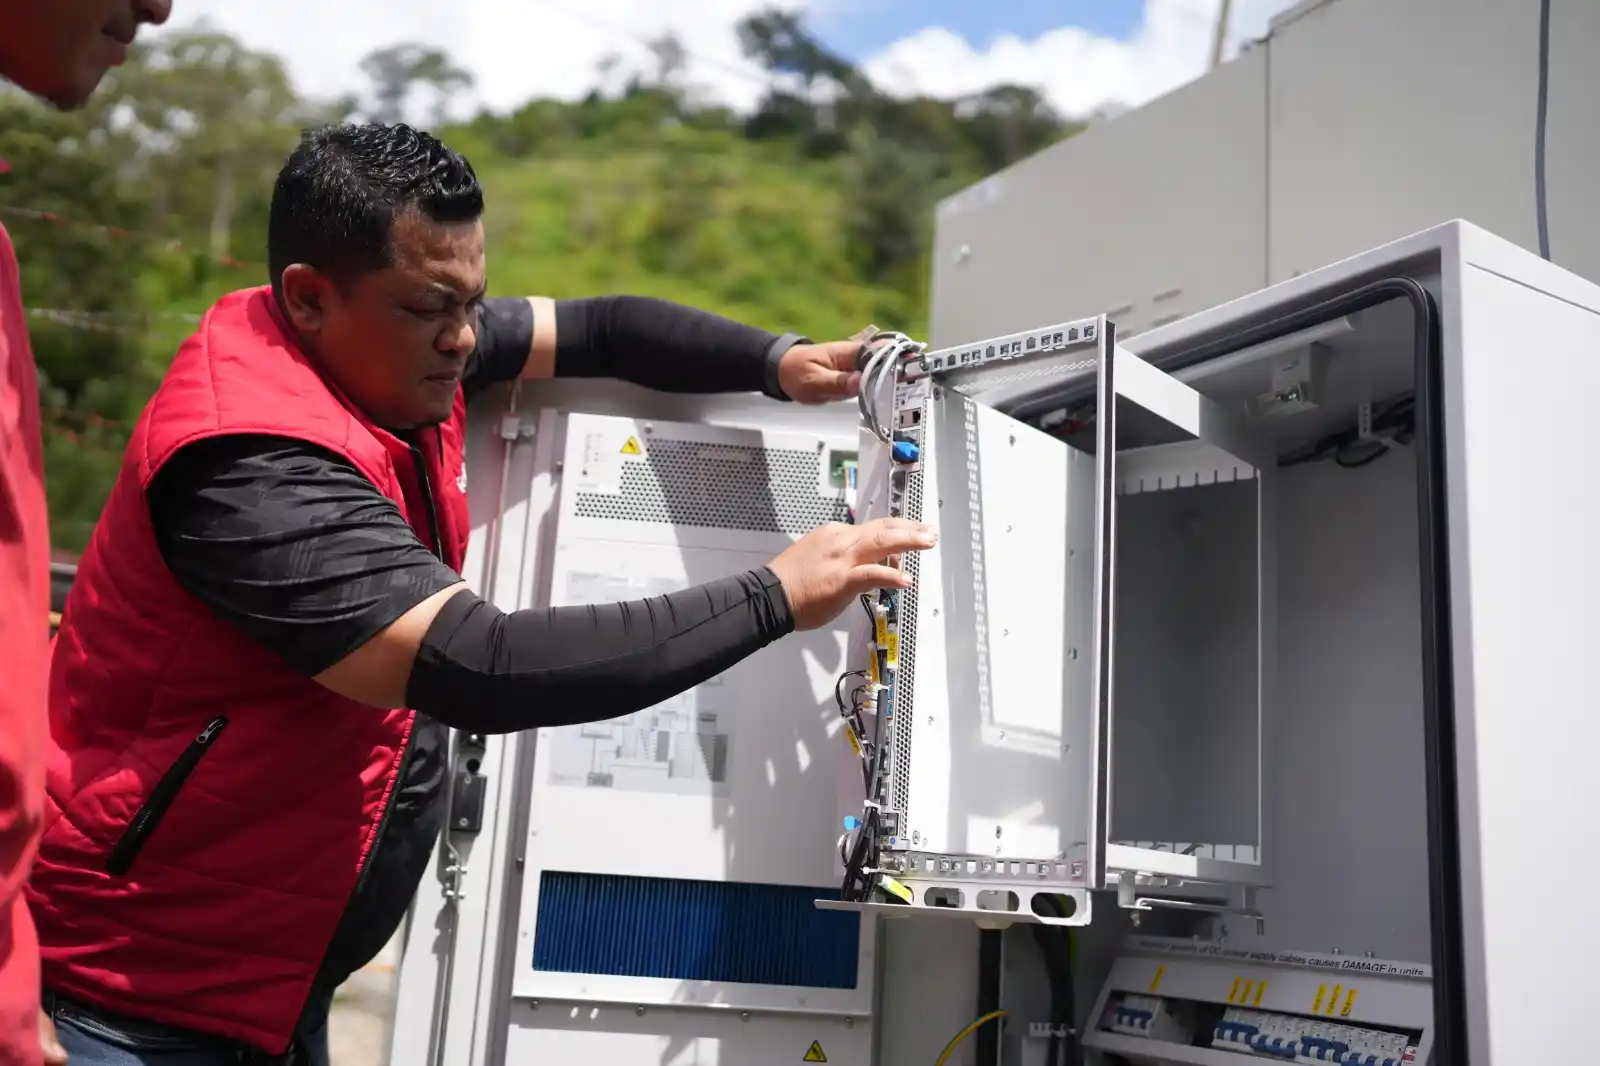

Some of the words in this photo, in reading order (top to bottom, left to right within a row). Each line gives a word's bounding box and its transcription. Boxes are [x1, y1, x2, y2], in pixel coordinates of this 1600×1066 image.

[1277, 953, 1306, 965] cables
[1308, 957, 1341, 969] causes
[1342, 959, 1387, 972] DAMAGE
[1388, 963, 1398, 974] in
[1398, 967, 1424, 976] units
